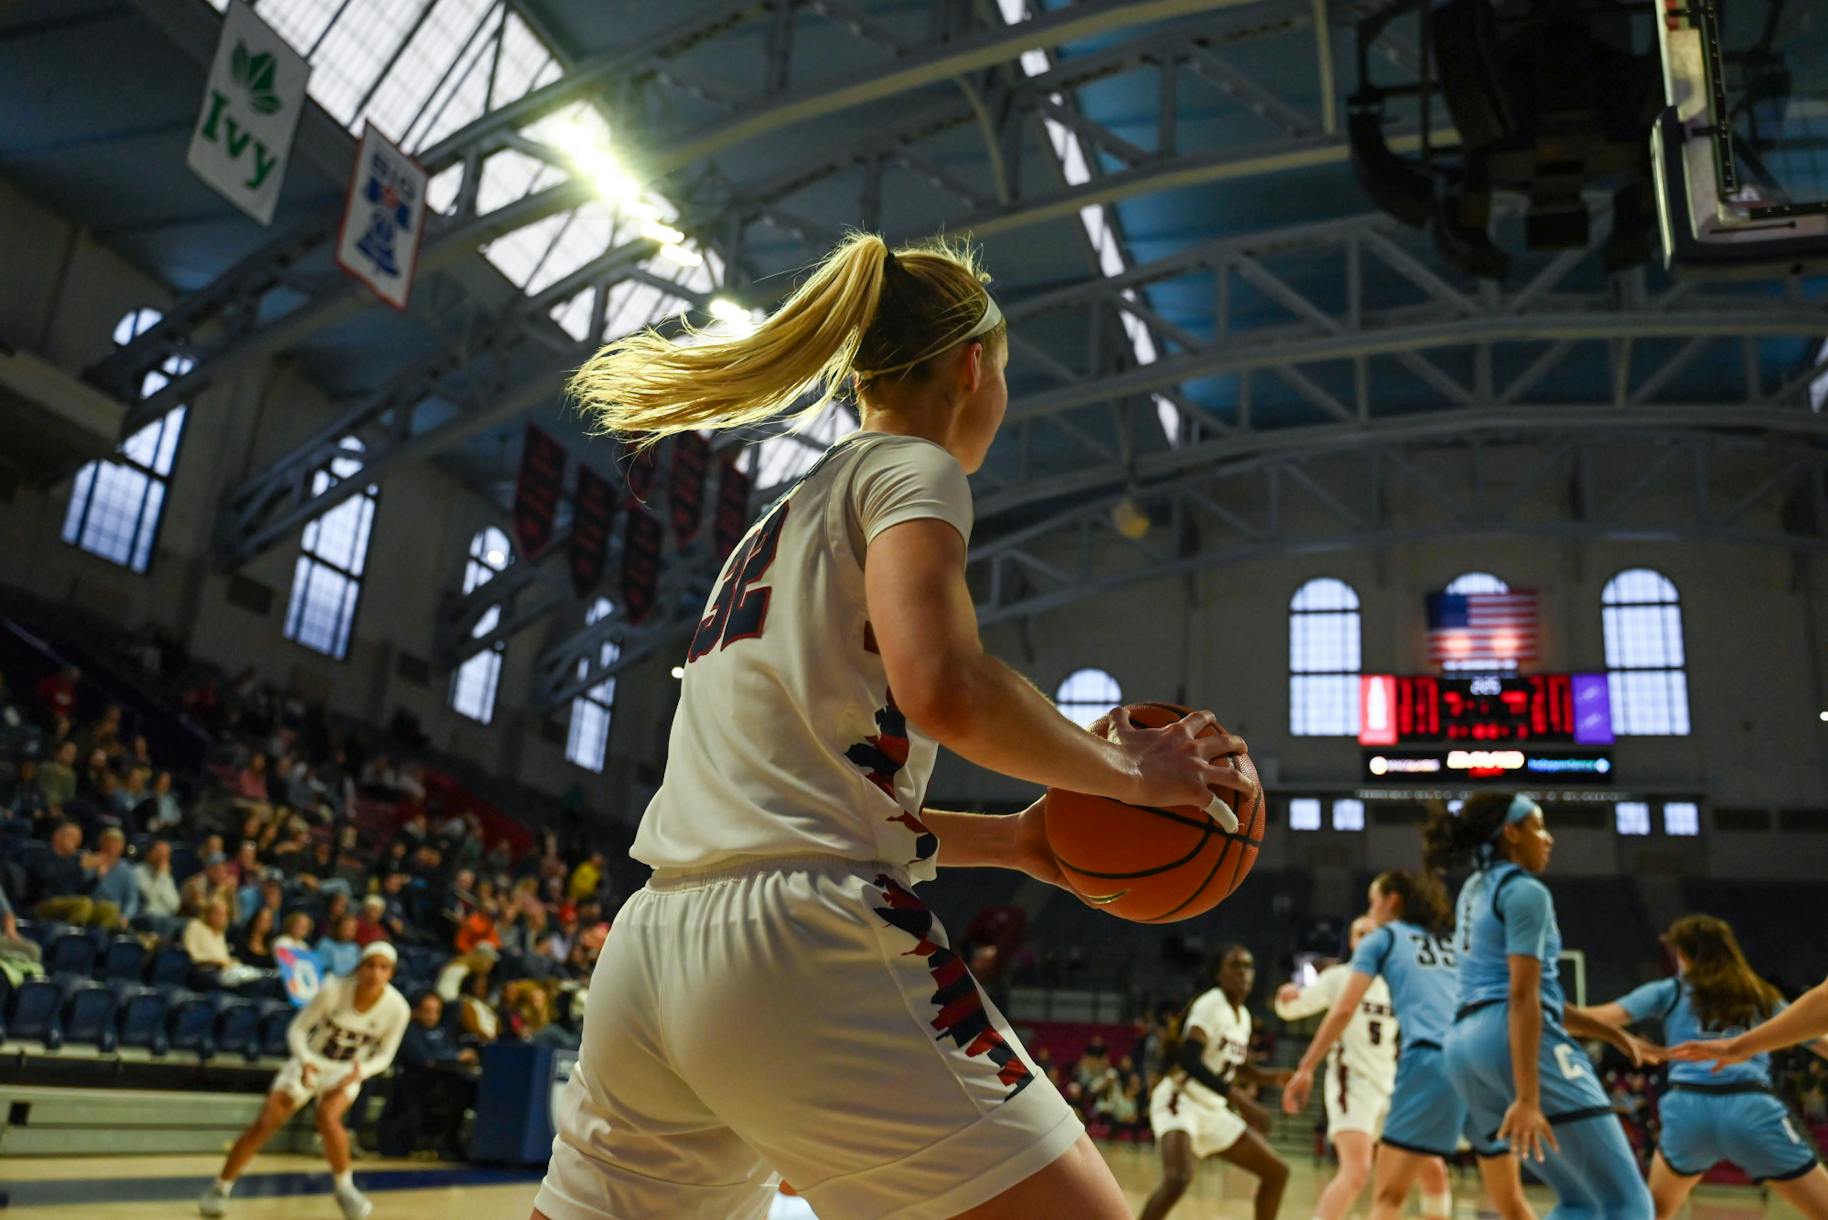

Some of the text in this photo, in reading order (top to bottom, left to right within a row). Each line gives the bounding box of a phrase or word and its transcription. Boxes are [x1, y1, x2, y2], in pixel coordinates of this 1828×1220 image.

[201, 87, 277, 191] Ivy
[688, 499, 790, 664] 32
[1410, 933, 1457, 969] 35
